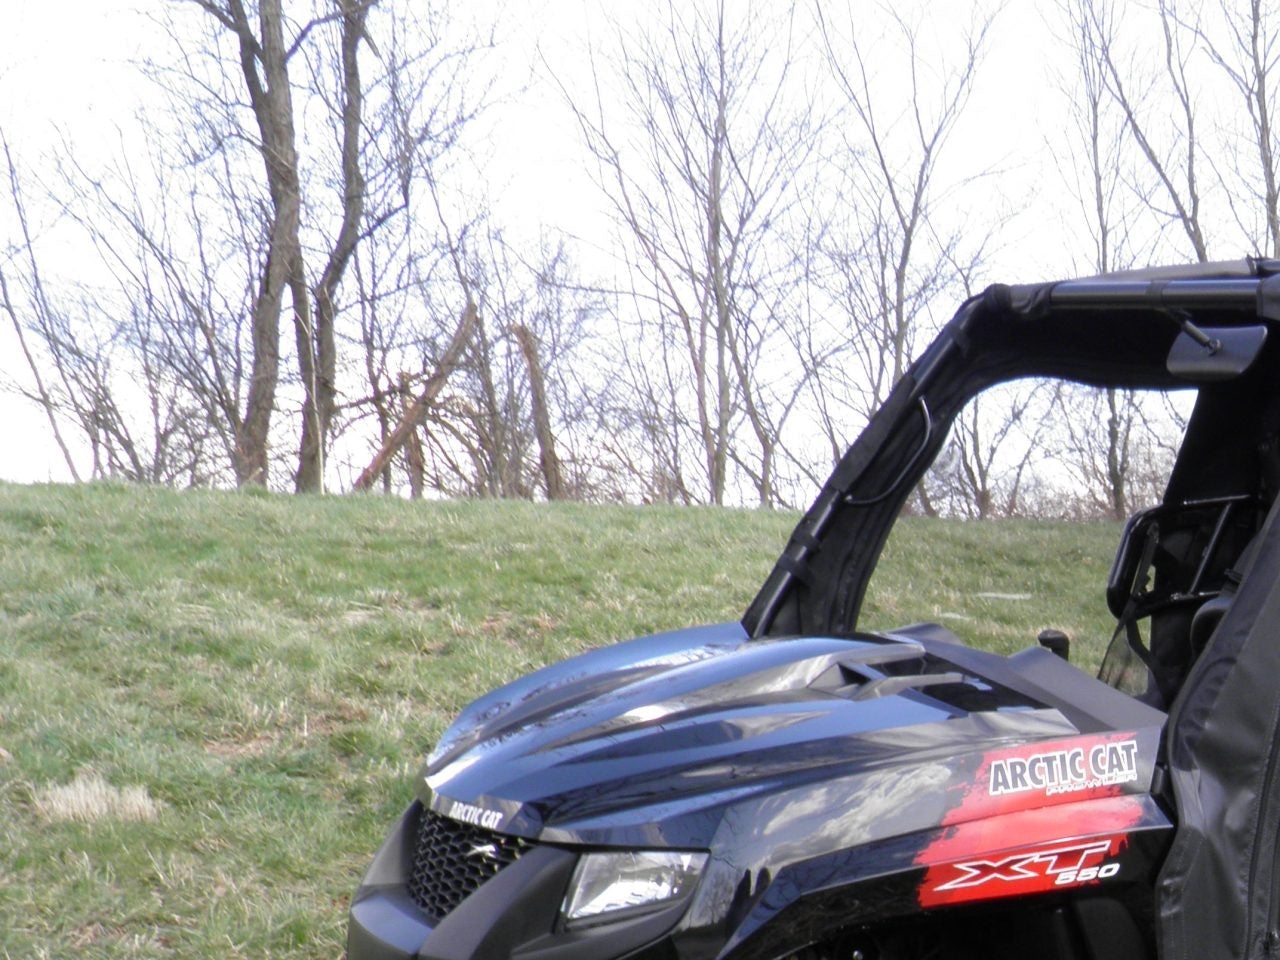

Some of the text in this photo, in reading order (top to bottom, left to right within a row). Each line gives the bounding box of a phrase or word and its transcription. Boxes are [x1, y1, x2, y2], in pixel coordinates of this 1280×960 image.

[988, 740, 1138, 796] ARCTIC CAT
[448, 801, 504, 829] ARCTIC CAT
[933, 840, 1111, 891] XT
[1055, 863, 1120, 885] 550
